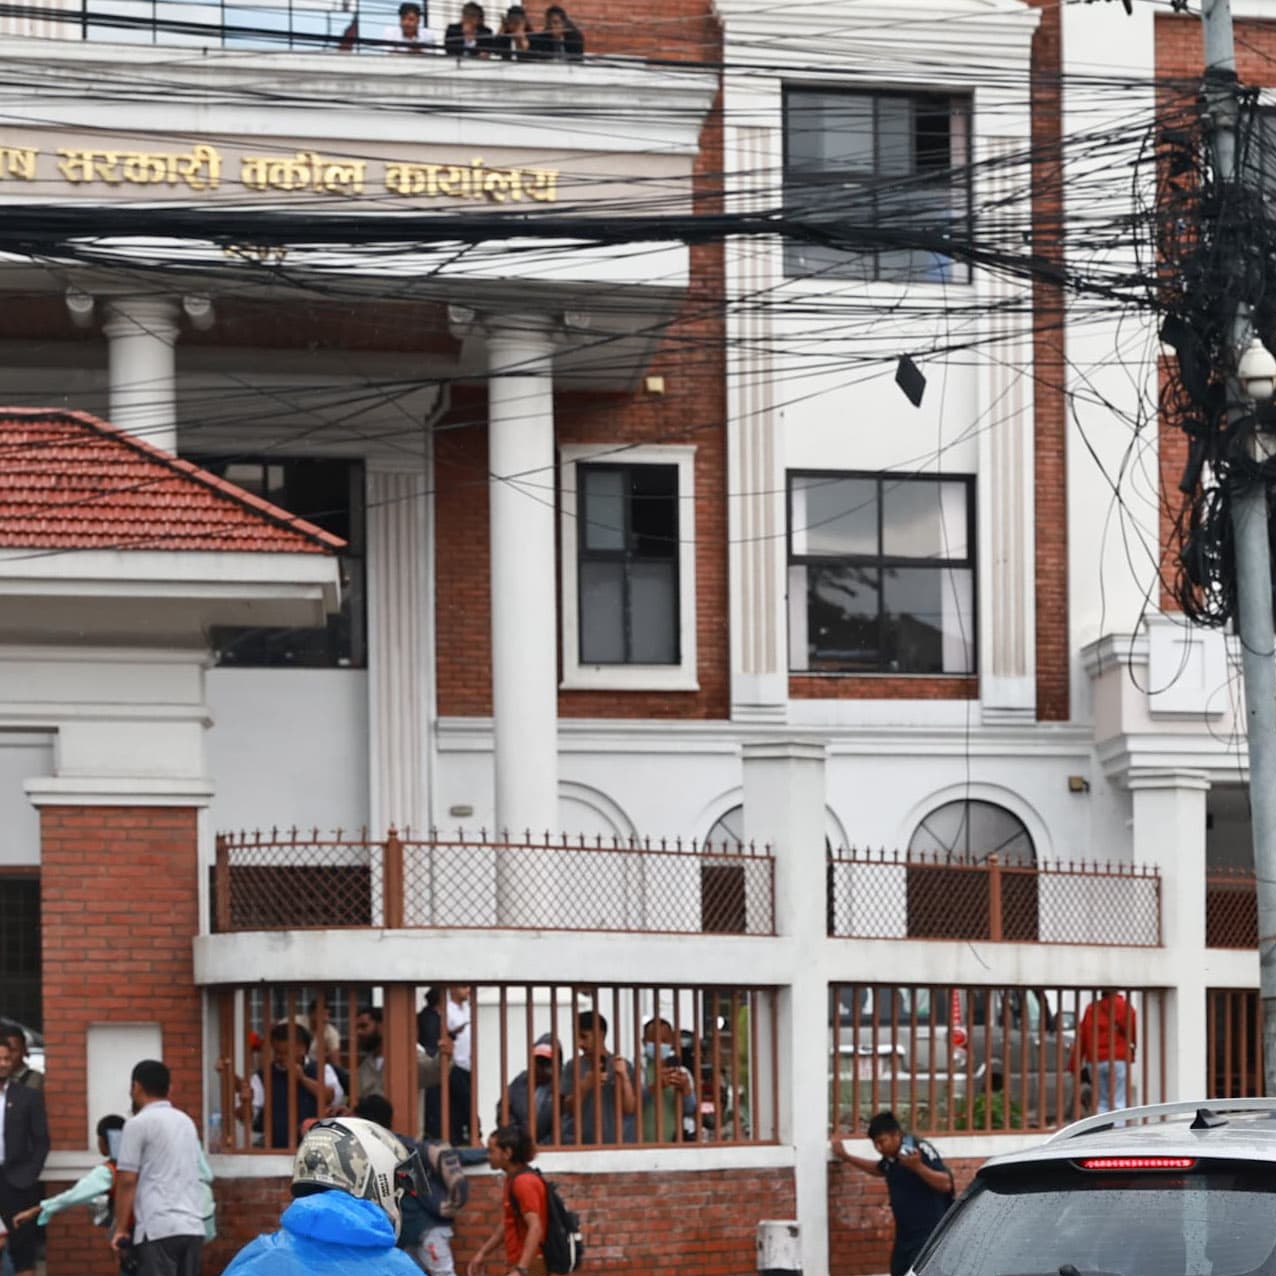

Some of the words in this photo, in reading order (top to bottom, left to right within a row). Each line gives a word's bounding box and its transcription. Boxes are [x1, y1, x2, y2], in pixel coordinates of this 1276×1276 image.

[0, 148, 39, 181] ष
[57, 145, 222, 190] सरकारी
[241, 151, 366, 194] वकील
[385, 157, 560, 202] कार्यालय
